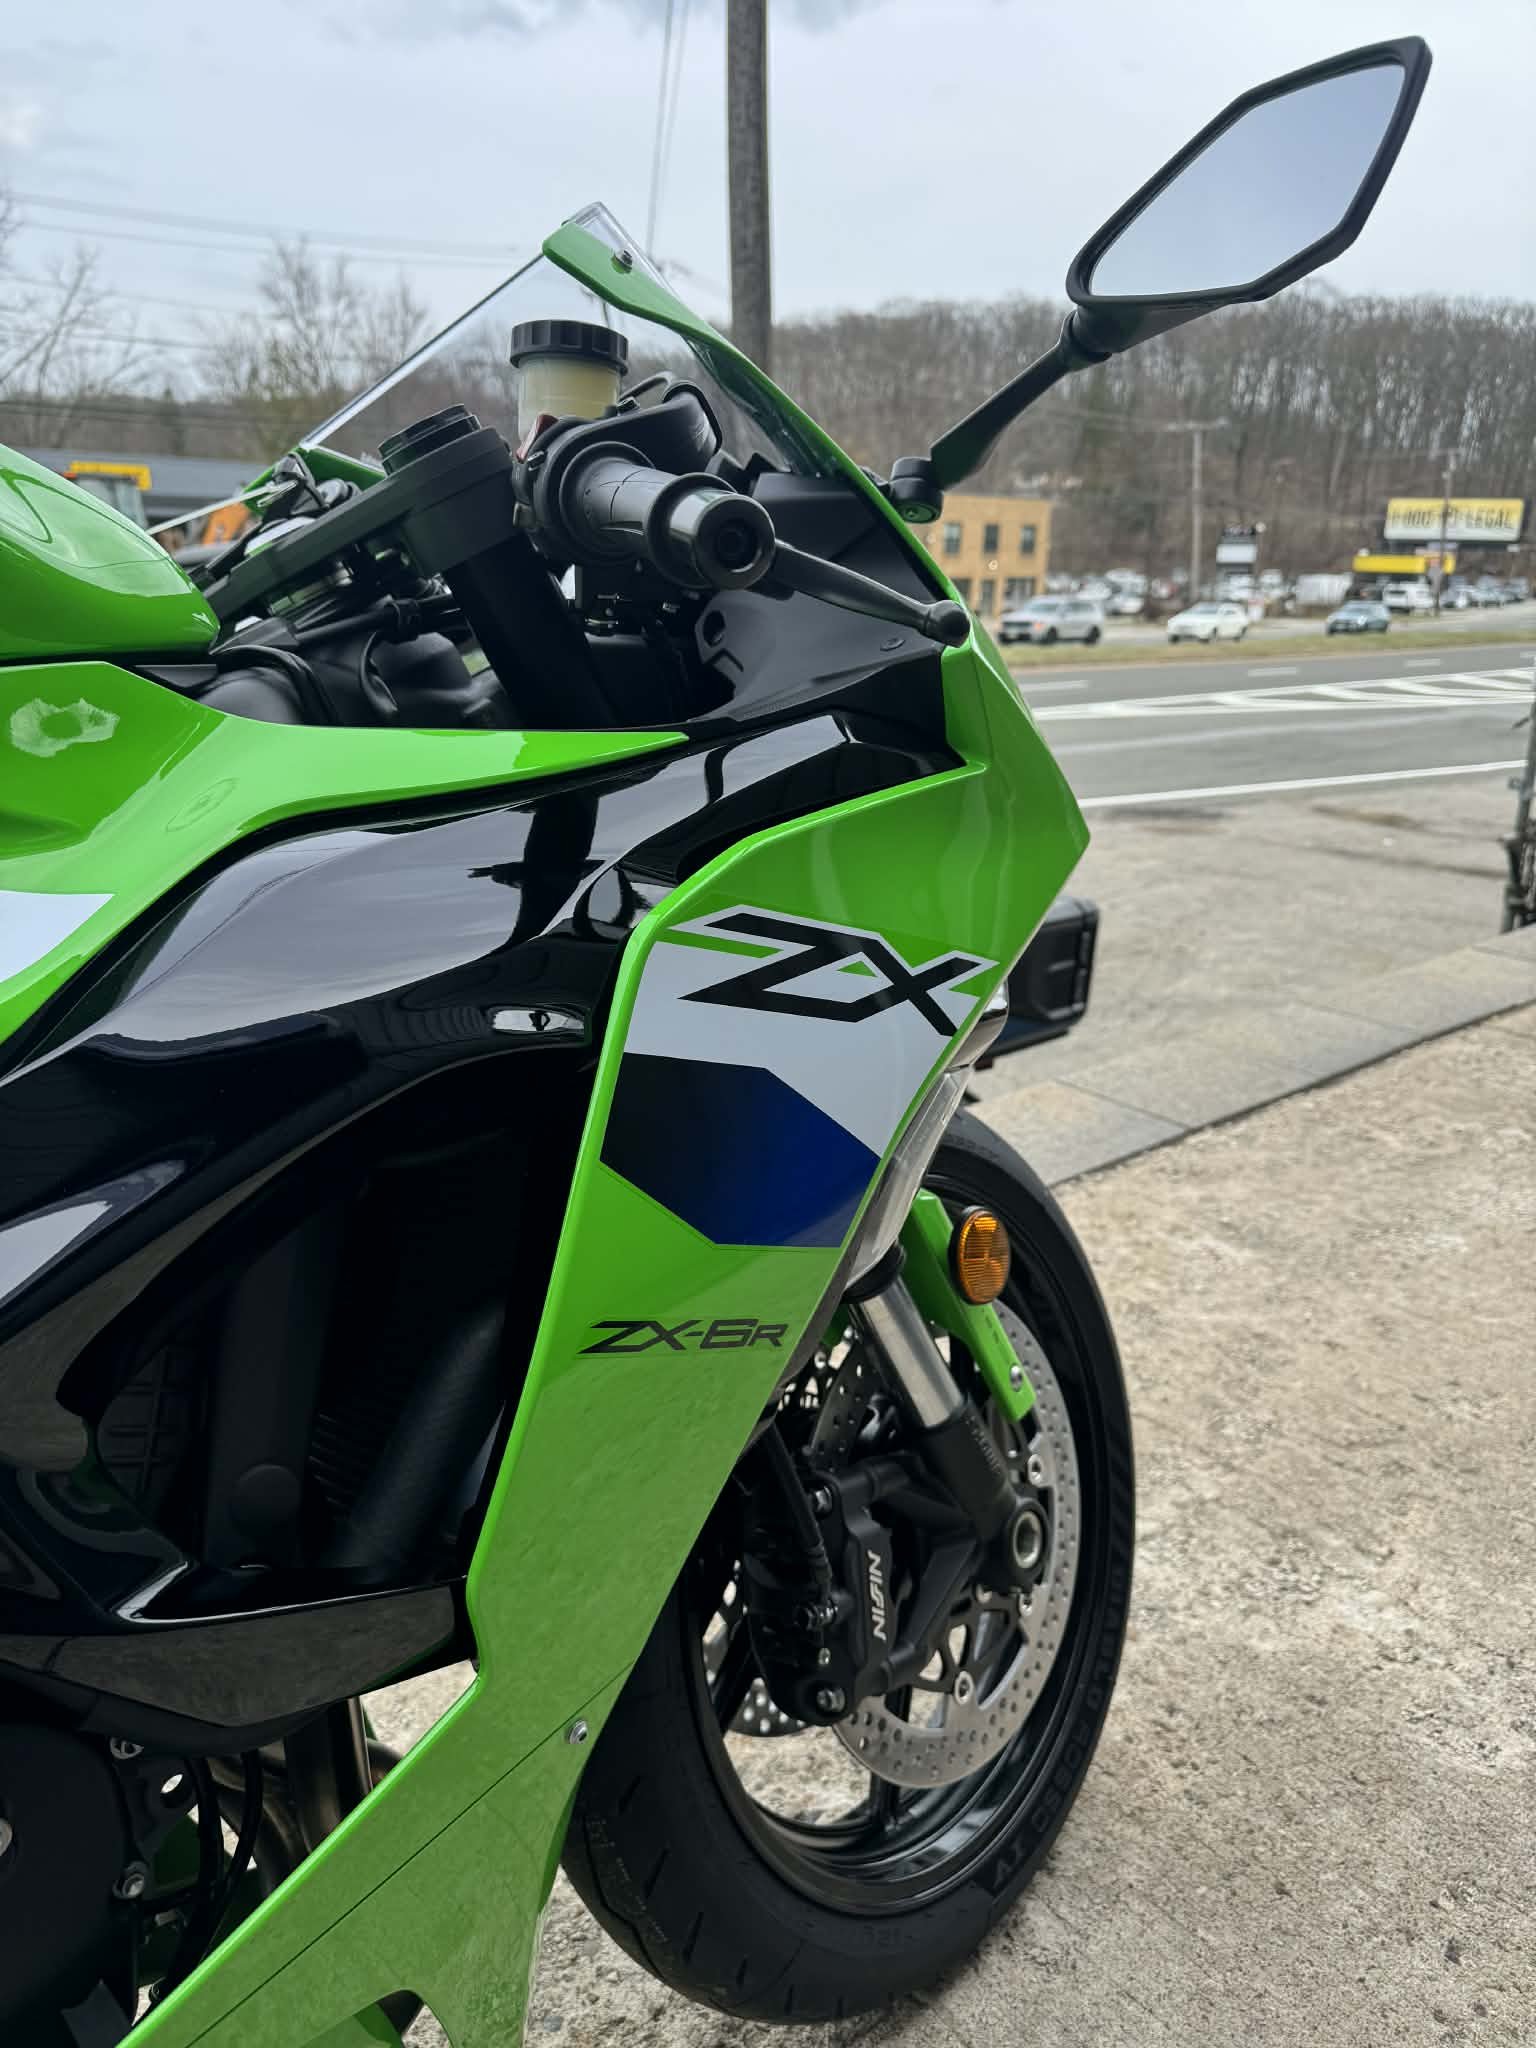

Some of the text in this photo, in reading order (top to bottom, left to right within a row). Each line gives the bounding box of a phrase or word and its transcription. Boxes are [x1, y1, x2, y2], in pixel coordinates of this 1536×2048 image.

[676, 912, 982, 1037] ZX
[576, 1318, 789, 1354] ZX-6R
[867, 1549, 887, 1643] NISSIN
